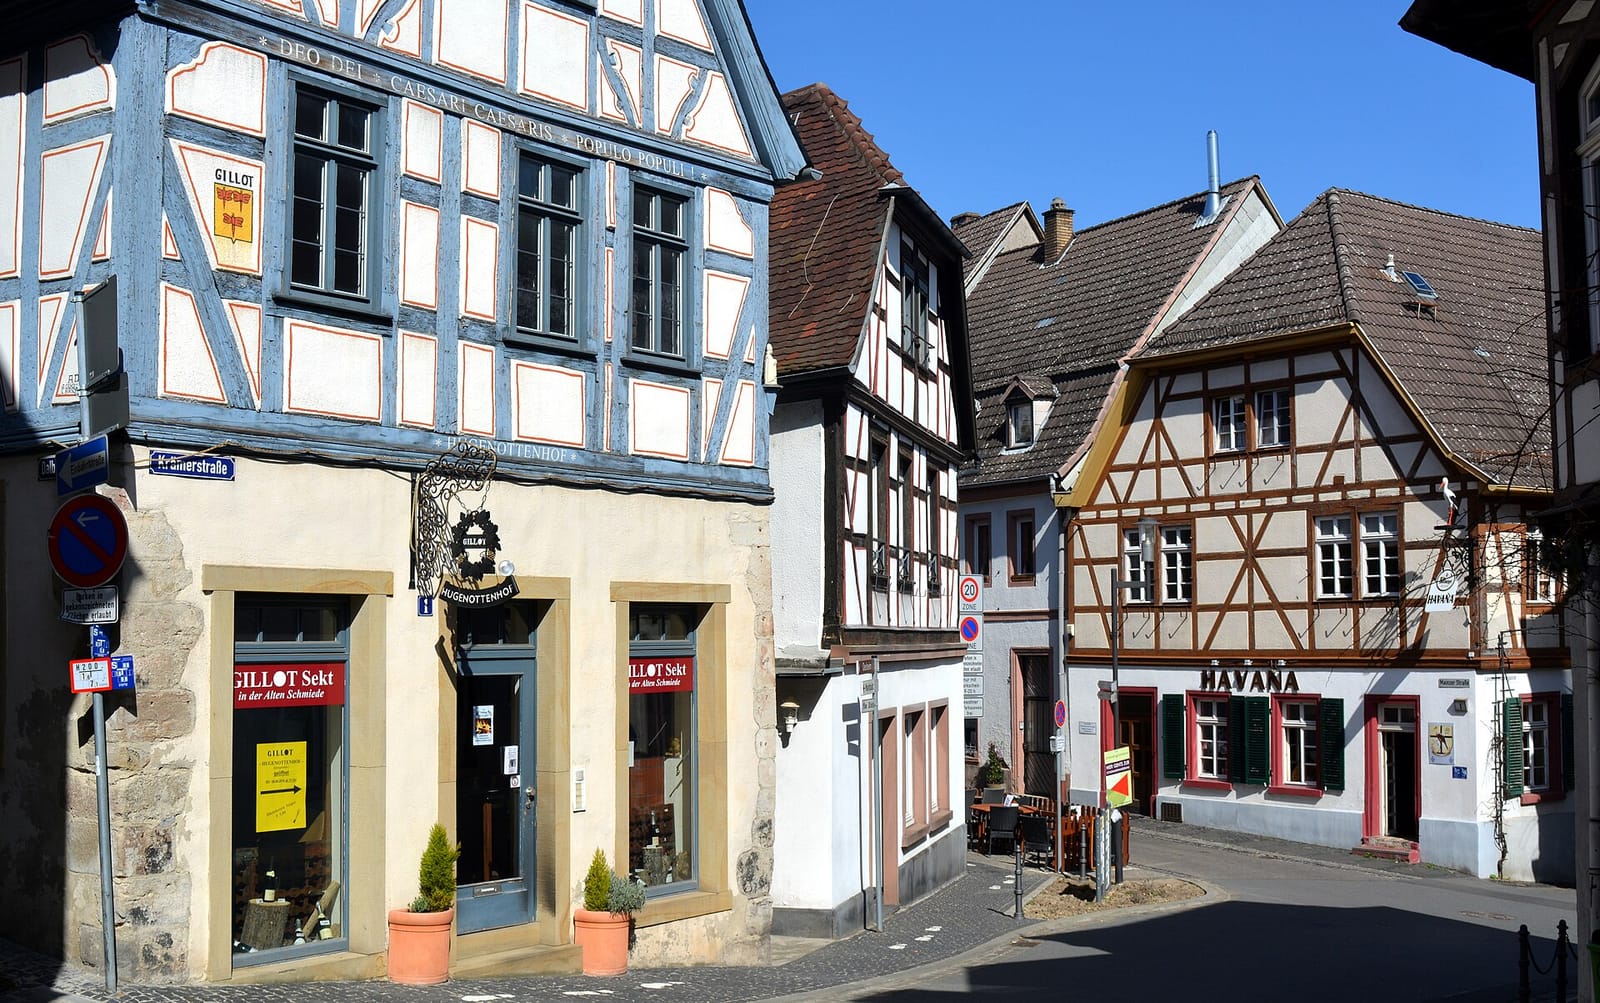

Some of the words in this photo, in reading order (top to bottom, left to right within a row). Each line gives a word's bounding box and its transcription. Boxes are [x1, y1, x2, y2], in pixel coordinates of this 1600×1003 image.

[279, 38, 321, 65] DEO
[330, 56, 363, 80] DEI
[390, 76, 466, 112] CAESARI
[474, 103, 554, 141] CAESARIS
[575, 134, 632, 162] POPULO
[638, 151, 684, 177] POPULI
[215, 168, 254, 187] GILLOT
[447, 436, 567, 461] HENOTTENHOF
[157, 454, 228, 475] Krämerstraße
[462, 538, 486, 546] GILLOT
[442, 584, 514, 605] HUGENOTTENHOF
[964, 584, 975, 596] 20
[234, 670, 299, 689] GILLOT
[301, 669, 334, 687] Sekt
[628, 663, 663, 678] ILLOT
[665, 663, 687, 677] Sekt
[631, 680, 641, 688] der
[641, 679, 655, 688] Alten
[655, 678, 681, 687] Schmiede
[1200, 669, 1300, 692] HAVANA
[238, 691, 247, 701] in
[248, 690, 263, 700] der
[263, 689, 285, 700] Alten
[286, 688, 325, 700] Schmiede
[267, 749, 293, 757] GILLOT
